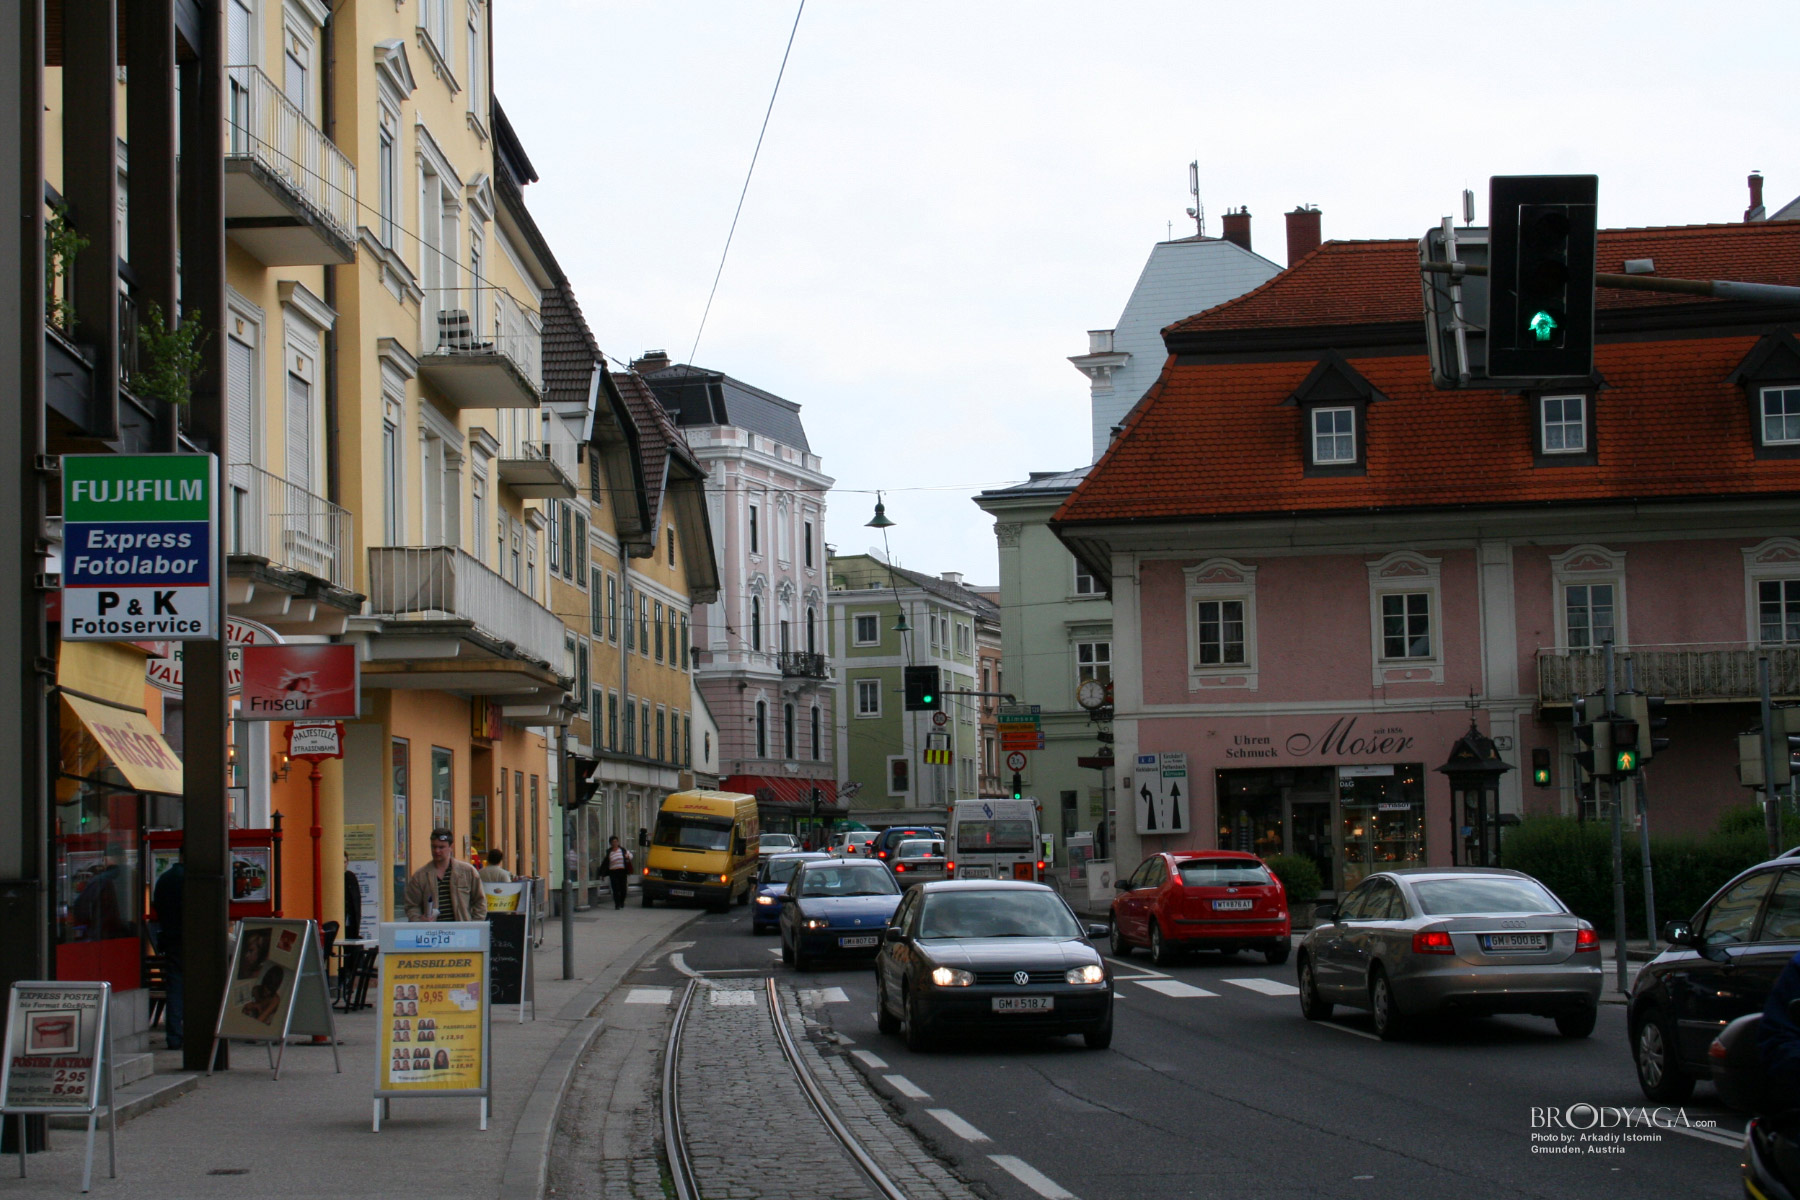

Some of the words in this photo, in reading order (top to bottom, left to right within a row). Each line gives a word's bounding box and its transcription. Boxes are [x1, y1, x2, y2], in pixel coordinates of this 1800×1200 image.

[72, 479, 202, 502] FUJIFILM
[87, 529, 191, 553] Express
[73, 555, 198, 575] Fotolabor
[97, 591, 120, 616] P
[127, 598, 143, 615] &
[153, 590, 178, 615] K
[71, 617, 202, 634] Fotoservice
[250, 695, 313, 712] Friseur
[293, 728, 337, 742] HALTESTELLE
[1285, 716, 1414, 757] Moser
[1387, 727, 1403, 735] 1856
[1233, 735, 1270, 746] Uhren
[1226, 748, 1278, 758] Schmuck
[416, 935, 450, 944] World
[1492, 935, 1505, 946] GM
[1511, 935, 1529, 945] 500
[1530, 935, 1542, 945] BE
[396, 958, 472, 969] PASSBILDER
[19, 992, 61, 1001] EXPRESS
[63, 992, 100, 1001] POSTER
[423, 991, 444, 1005] 9,95
[998, 998, 1013, 1009] GM
[1020, 998, 1038, 1009] 518
[1040, 998, 1048, 1008] Z
[12, 1056, 52, 1068] POSTER
[54, 1069, 87, 1084] 2,95
